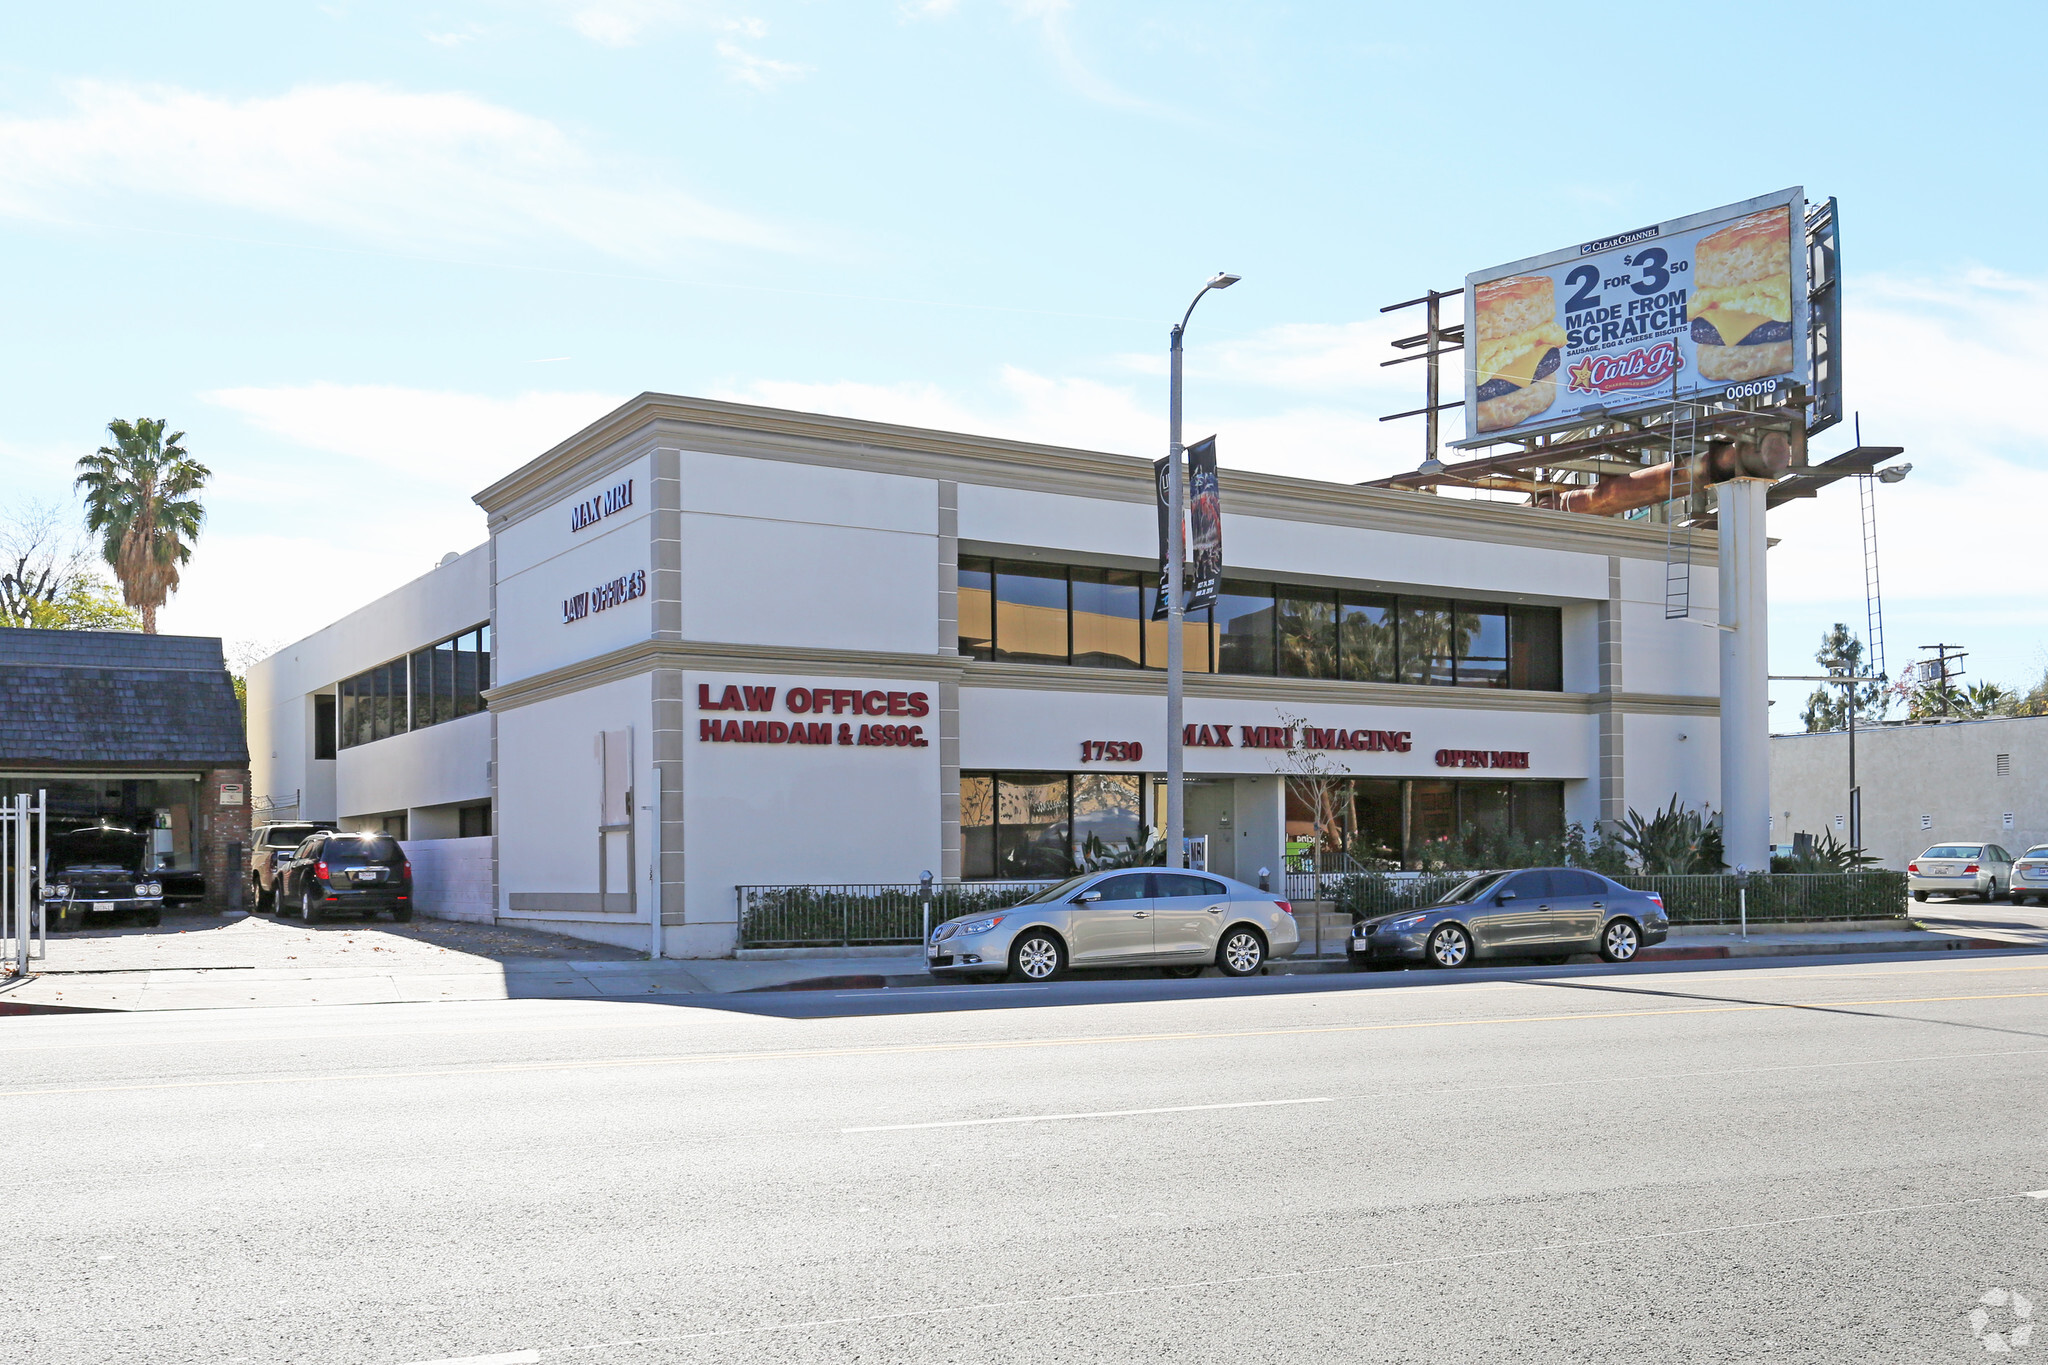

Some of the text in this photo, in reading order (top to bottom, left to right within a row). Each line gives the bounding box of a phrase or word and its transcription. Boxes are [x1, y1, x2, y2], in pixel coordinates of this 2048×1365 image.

[1565, 264, 1600, 314] 2
[1604, 274, 1630, 290] FOR
[1566, 289, 1687, 330] MADE FROM
[1566, 305, 1687, 349] SCRATCH
[1566, 345, 1601, 357] SAUSAGE,
[1602, 341, 1616, 349] EGG
[1625, 333, 1653, 344] CHEESE
[1655, 325, 1688, 338] BISCUITS
[1590, 351, 1647, 385] Carl's
[1726, 379, 1777, 400] 006019
[571, 479, 634, 533] MAX MRI
[562, 569, 646, 624] LAW OFFICES
[698, 683, 930, 717] LAW OFFICES
[699, 718, 929, 747] HAMDAM & ASSOC.
[1182, 723, 1413, 753] MAX MRI IMAGING
[1080, 740, 1143, 764] 17530
[1435, 749, 1530, 769] OPEN MRI
[1190, 842, 1204, 862] MRI
